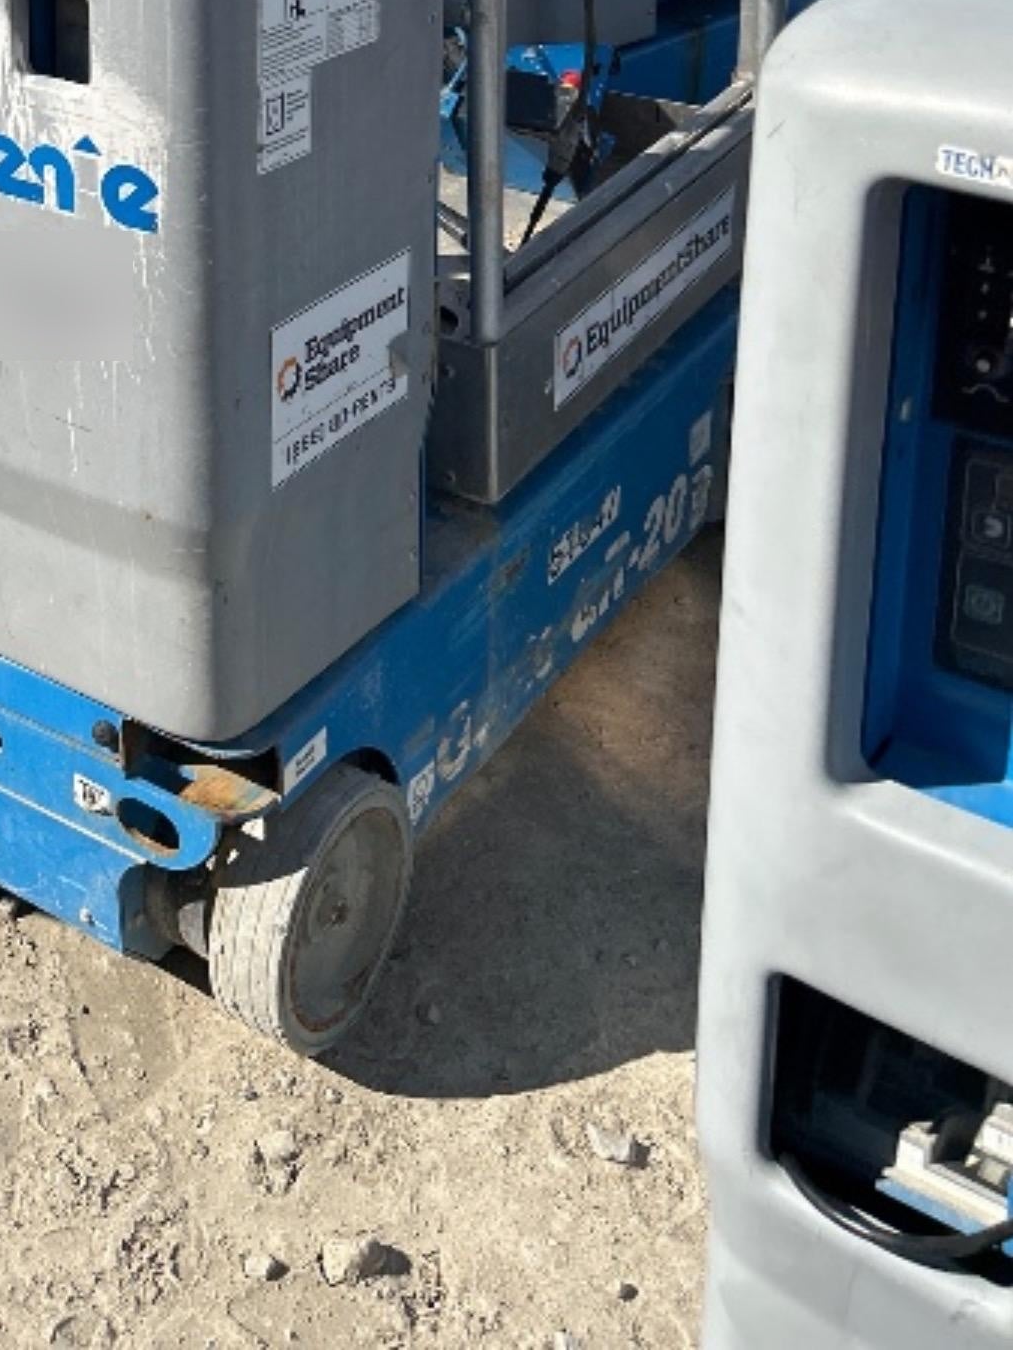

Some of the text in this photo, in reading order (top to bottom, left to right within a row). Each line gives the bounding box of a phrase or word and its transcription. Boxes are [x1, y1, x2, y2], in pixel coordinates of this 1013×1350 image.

[304, 285, 405, 364] Equipment
[586, 213, 730, 357] EquipmentShare
[303, 344, 362, 391] Share
